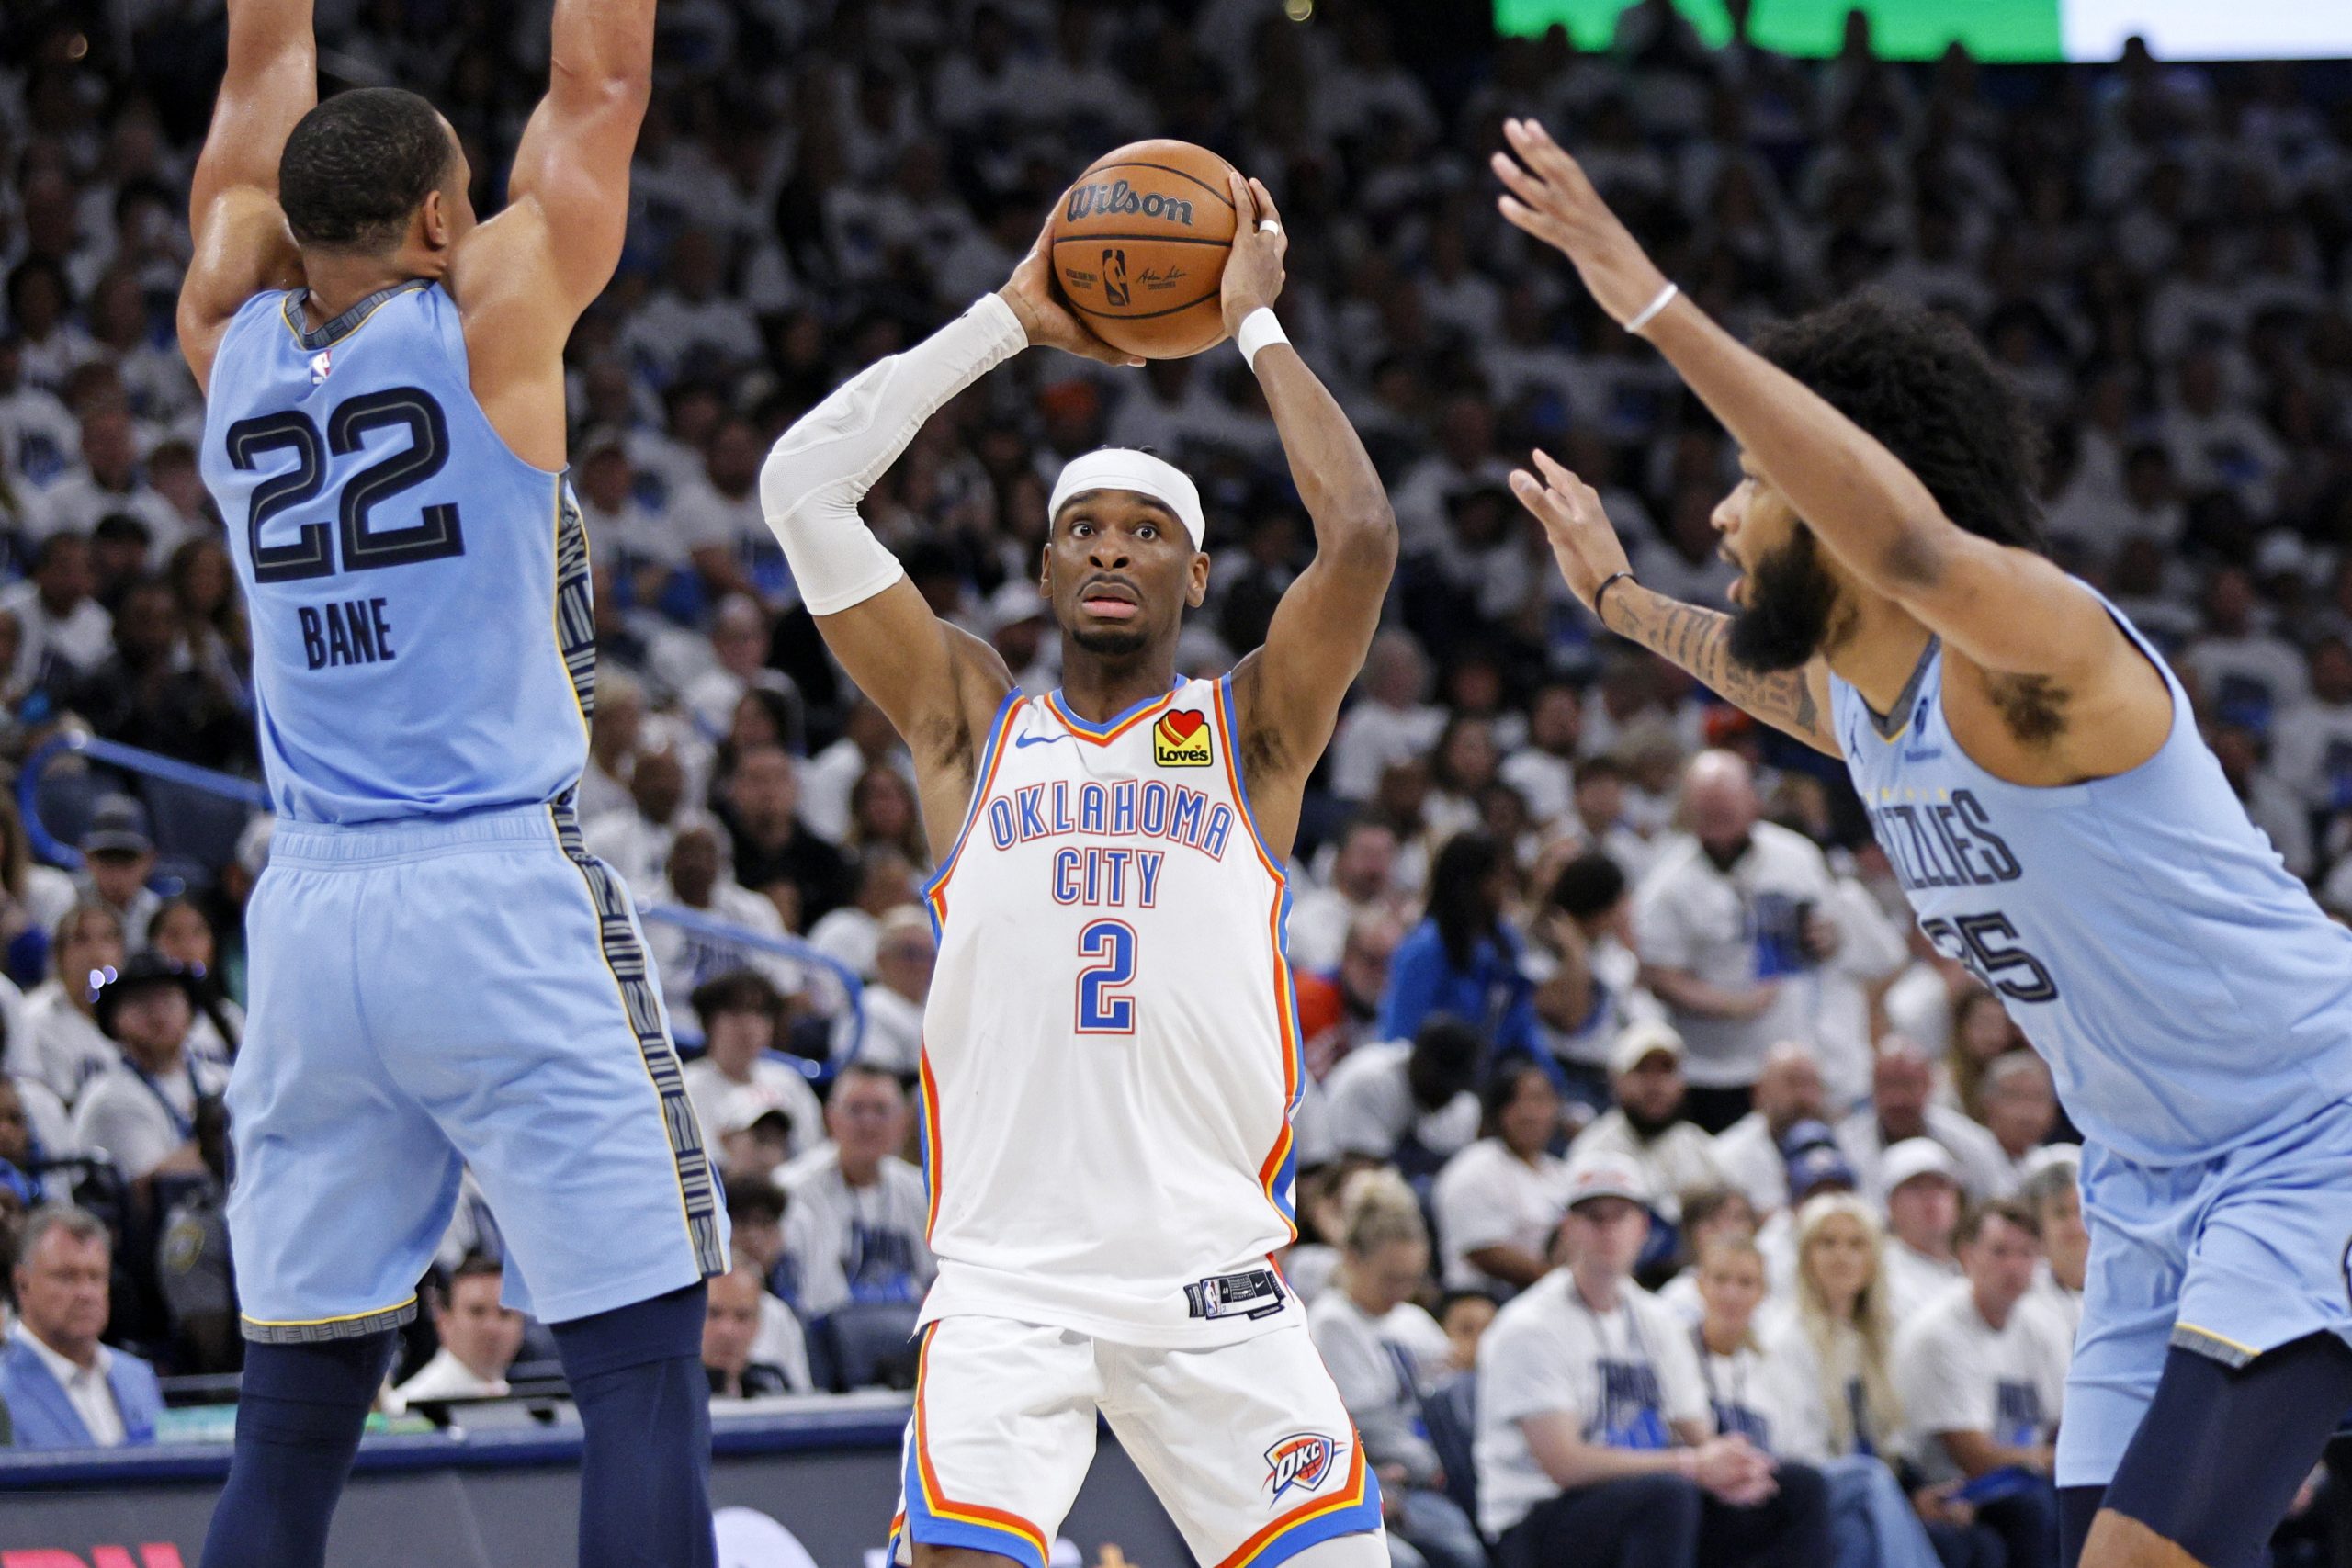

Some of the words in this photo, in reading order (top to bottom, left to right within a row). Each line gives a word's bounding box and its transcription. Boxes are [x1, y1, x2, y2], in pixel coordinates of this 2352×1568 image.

[1067, 179, 1193, 226] Wilson
[226, 386, 466, 583] 22
[298, 597, 396, 671] BANE
[988, 779, 1235, 862] OKLAHOMA
[1052, 846, 1165, 908] CITY
[1074, 918, 1138, 1035] 2
[1273, 1440, 1320, 1493] OKC
